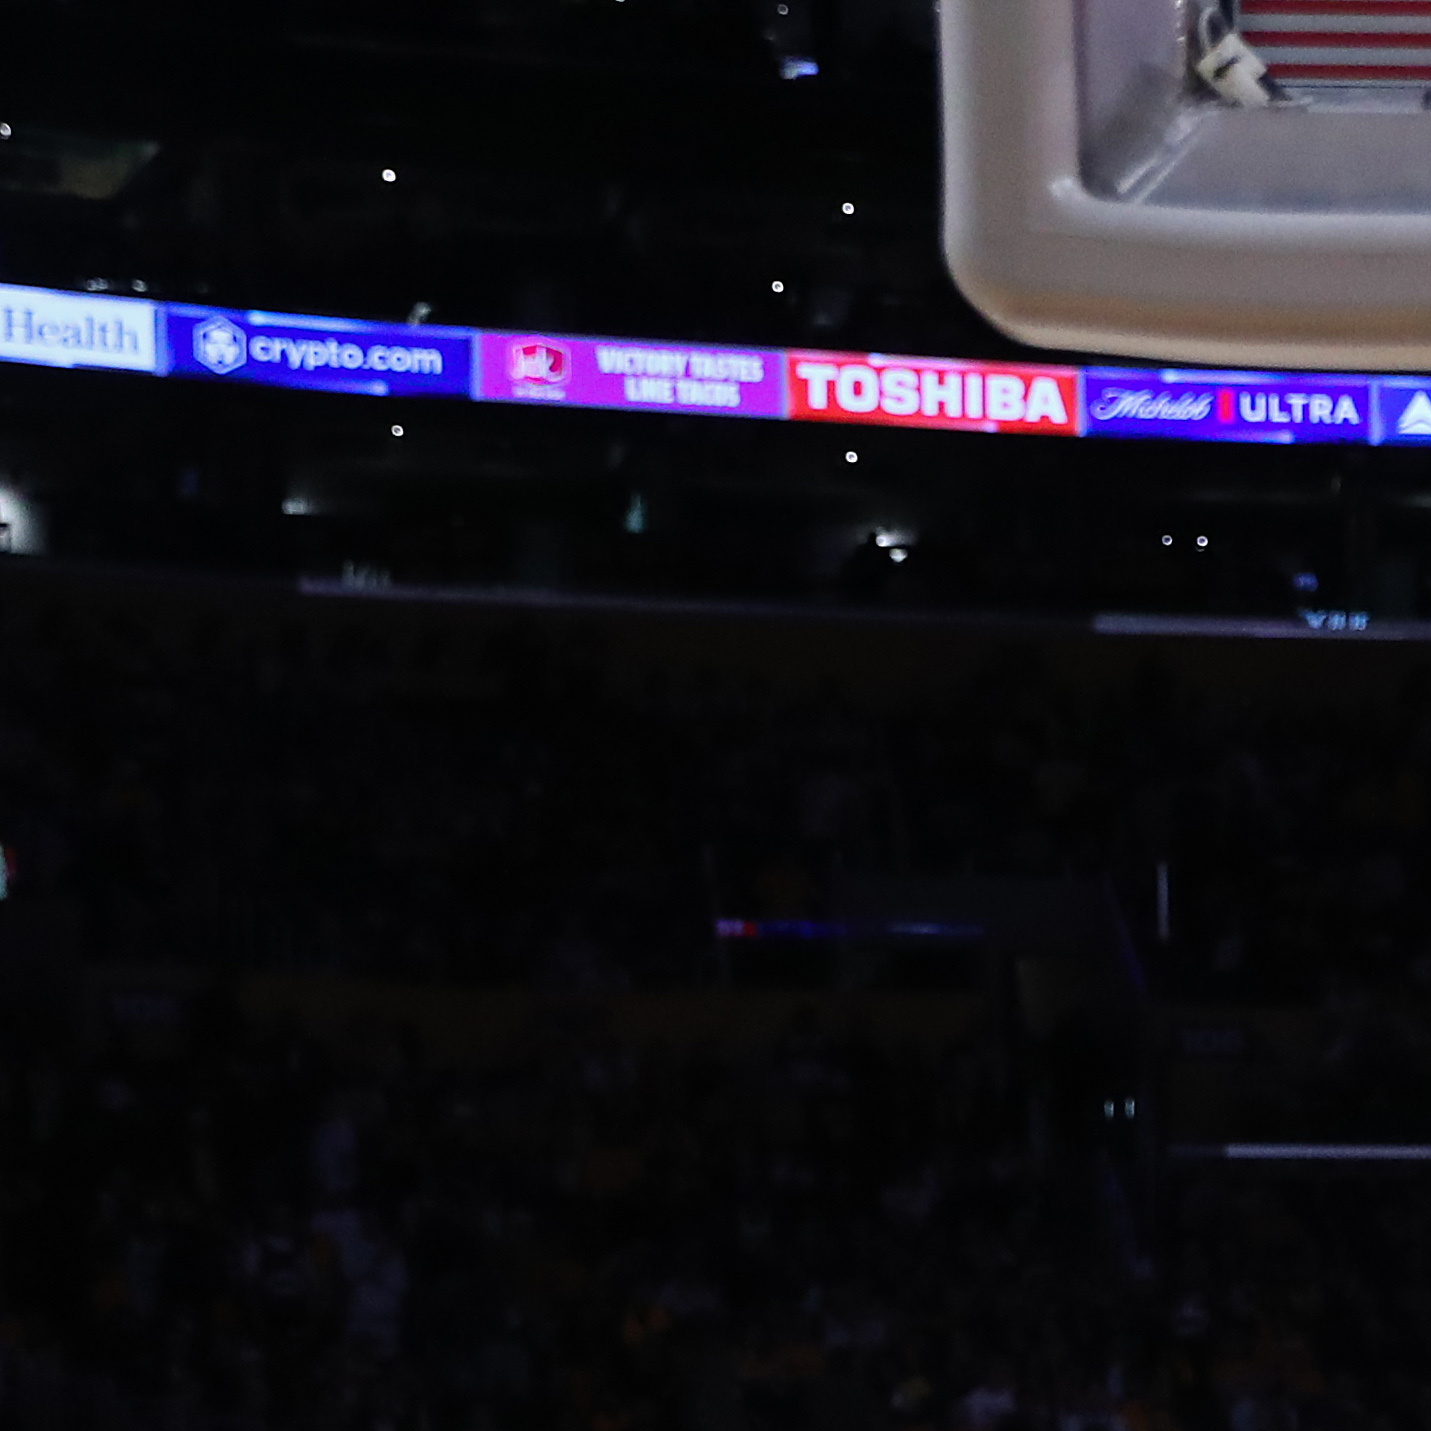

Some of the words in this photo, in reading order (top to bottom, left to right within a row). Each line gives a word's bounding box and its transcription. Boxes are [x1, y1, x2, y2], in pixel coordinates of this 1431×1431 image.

[4, 306, 139, 355] Health
[249, 334, 443, 375] crypto.com
[797, 363, 1069, 424] TOSHIBA
[1090, 387, 1214, 421] Michelob
[1239, 391, 1360, 425] ULTRA
